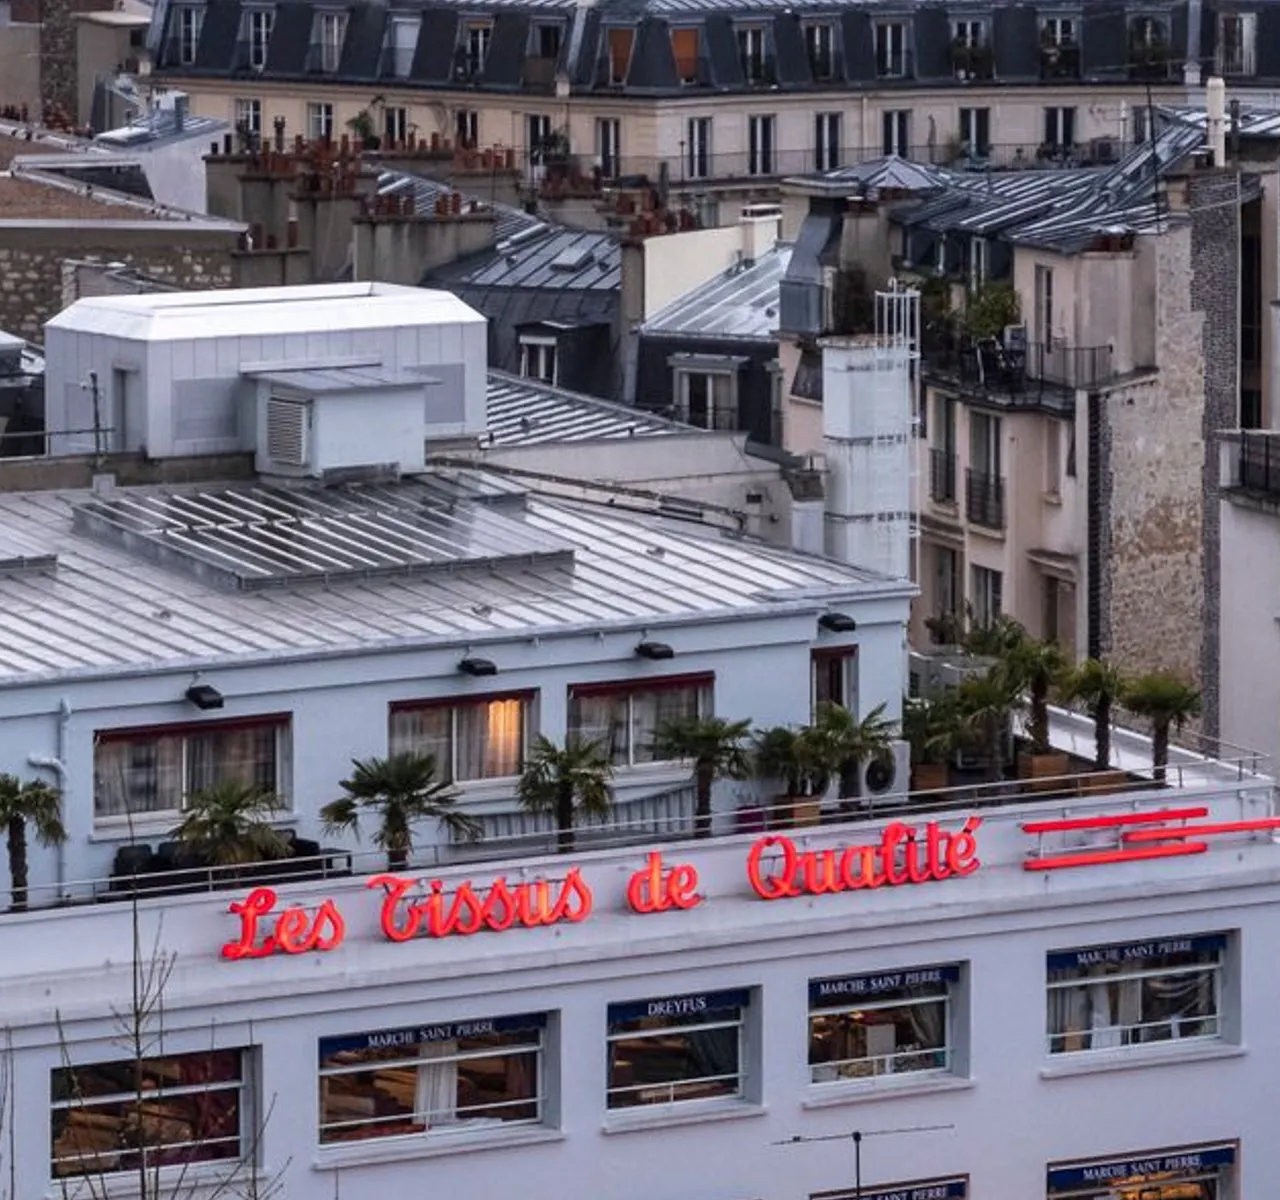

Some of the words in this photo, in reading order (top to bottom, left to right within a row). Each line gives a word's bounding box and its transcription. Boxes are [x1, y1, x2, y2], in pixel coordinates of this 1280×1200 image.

[222, 886, 345, 960] Les
[366, 866, 593, 942] Tissus
[627, 850, 702, 913] de
[747, 815, 982, 900] Qualité
[820, 979, 867, 995] MARCHE
[870, 974, 902, 989] SAINT
[905, 970, 941, 984] PIERRE
[648, 997, 706, 1015] DREYFUS
[420, 1025, 452, 1041] SAINT
[1083, 1166, 1127, 1180] MARCHE
[1131, 1161, 1161, 1174] SAINT
[1165, 1155, 1201, 1169] PIERRE
